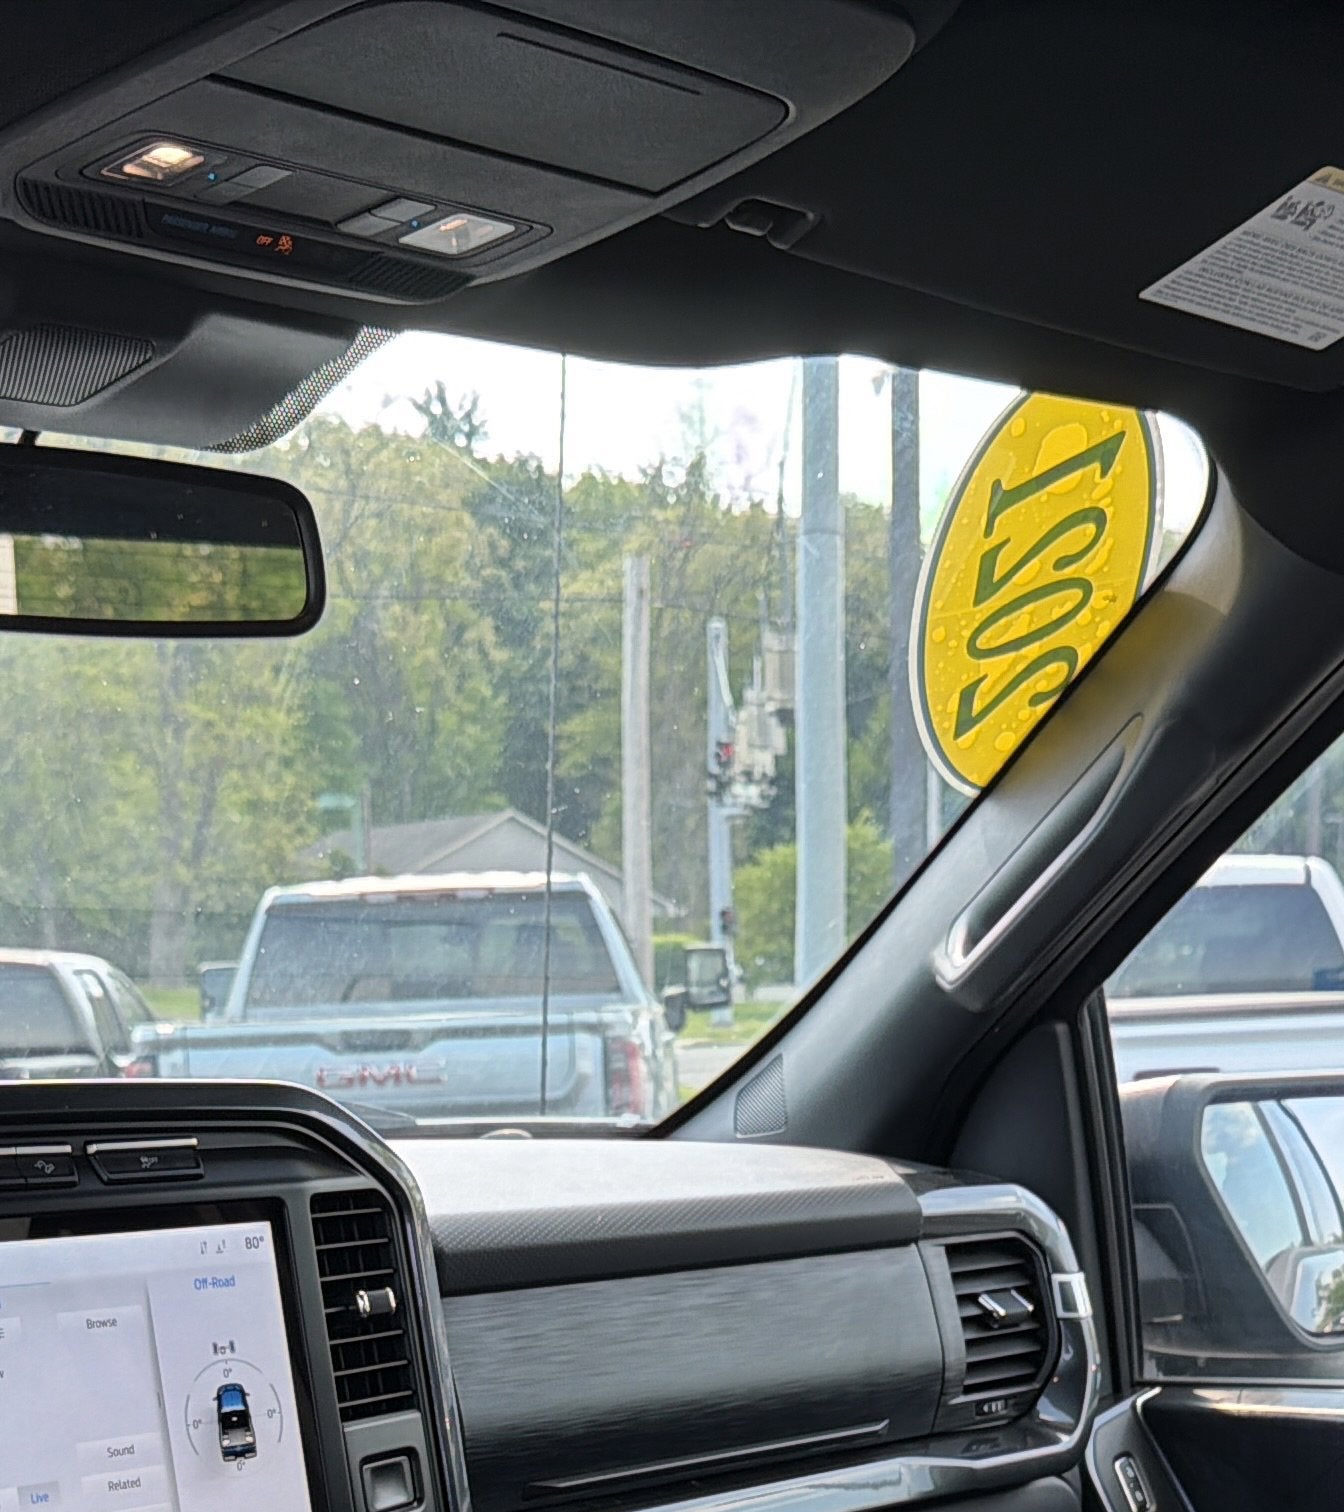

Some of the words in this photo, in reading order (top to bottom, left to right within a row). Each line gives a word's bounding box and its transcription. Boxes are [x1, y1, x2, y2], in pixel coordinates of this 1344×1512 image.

[316, 1059, 448, 1088] GMC
[194, 1276, 235, 1290] Off-Road
[86, 1317, 118, 1329] Browse
[107, 1444, 135, 1458] Sound
[108, 1477, 141, 1492] Related
[30, 1492, 49, 1504] Live
